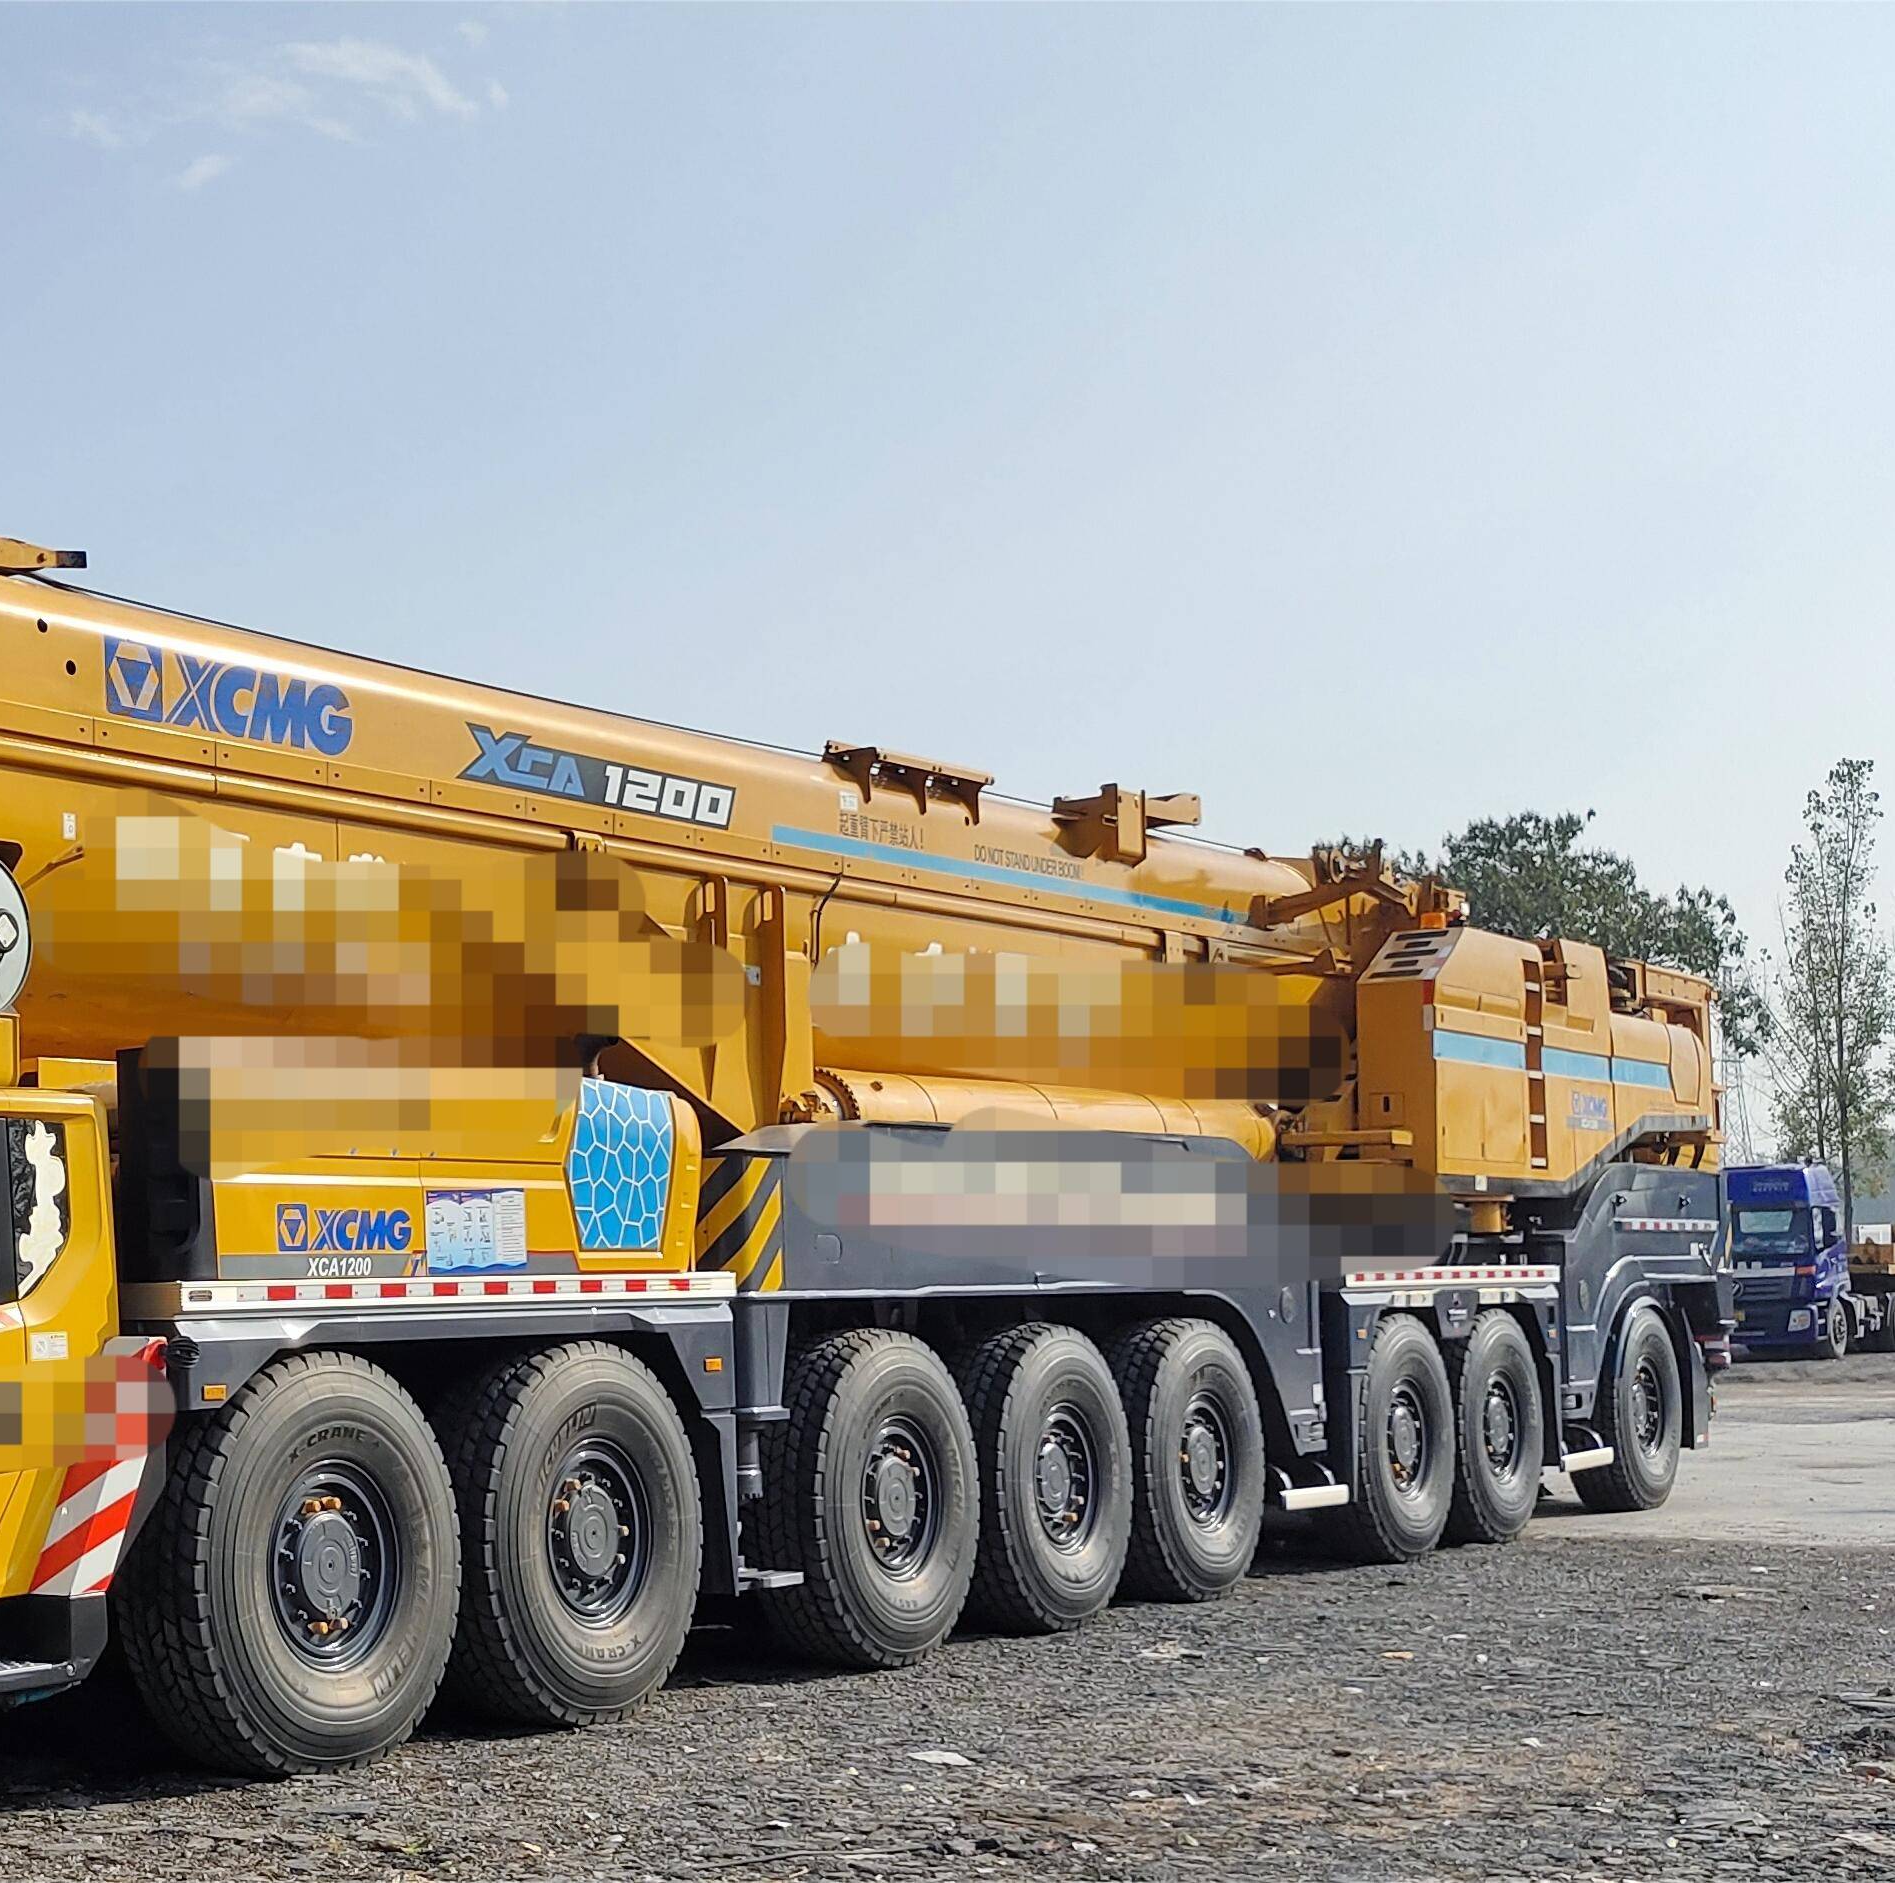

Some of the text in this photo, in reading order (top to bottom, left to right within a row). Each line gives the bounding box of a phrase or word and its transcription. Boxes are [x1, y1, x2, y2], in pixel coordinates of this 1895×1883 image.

[165, 653, 352, 756] XCMG
[604, 764, 735, 827] 1200
[974, 844, 986, 862] DO
[987, 847, 1003, 866] NOT
[1005, 850, 1030, 871] STAND
[1031, 855, 1057, 875] UNDER
[309, 1209, 412, 1250] XCMG
[307, 1257, 372, 1277] XCA1200
[288, 1427, 367, 1464] X-CRANE
